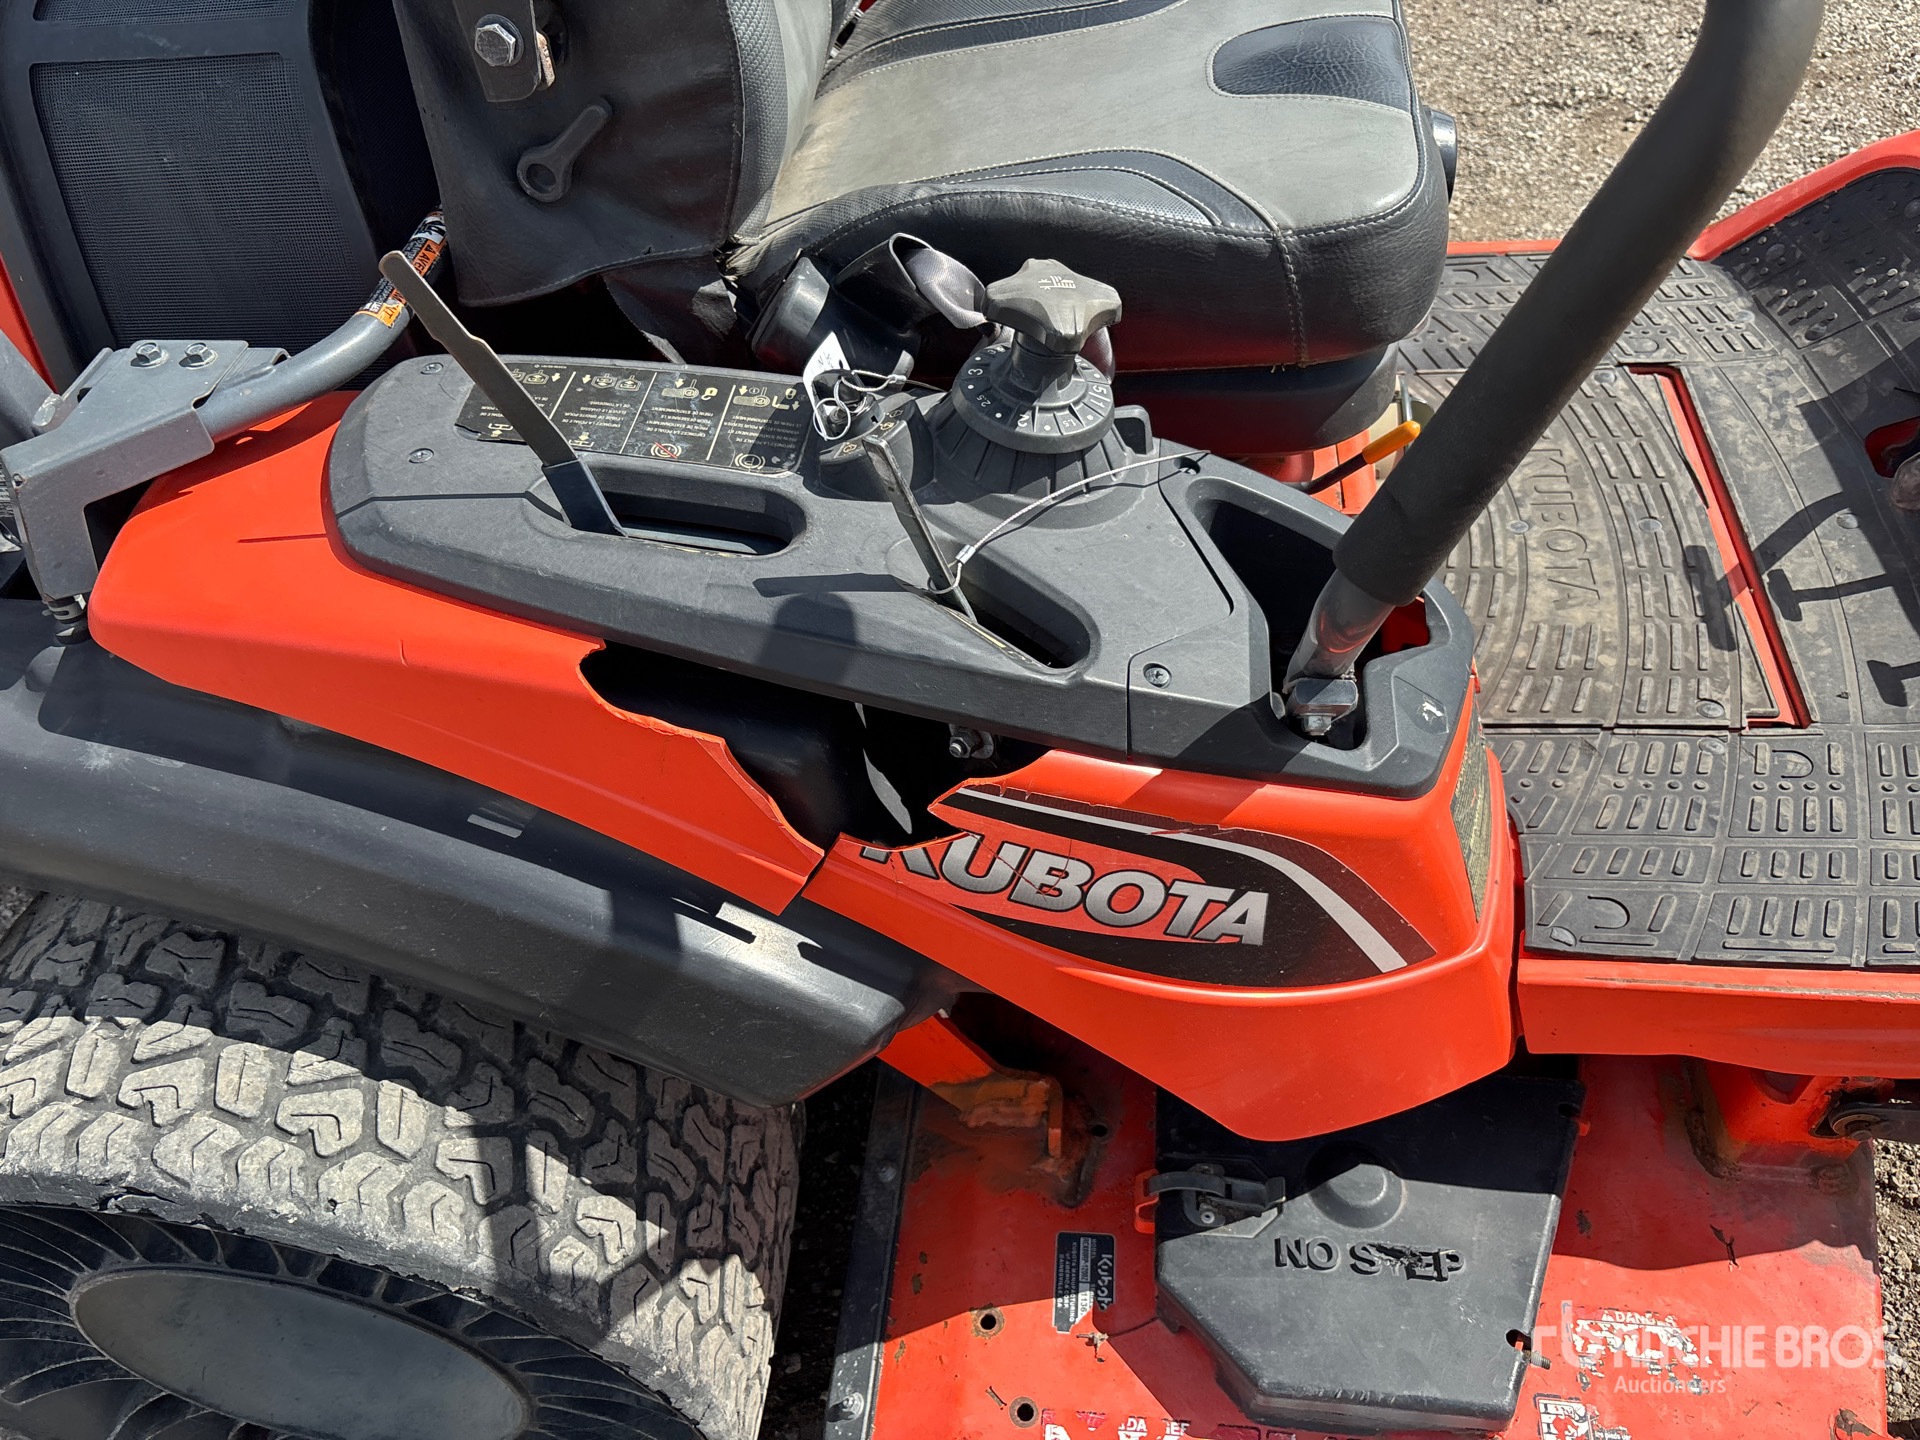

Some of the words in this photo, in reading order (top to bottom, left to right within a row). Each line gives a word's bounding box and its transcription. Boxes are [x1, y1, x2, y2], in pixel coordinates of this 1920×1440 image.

[967, 368, 984, 376] 3
[976, 394, 992, 408] 2.5
[1017, 413, 1030, 428] 2
[1062, 418, 1077, 428] 1.5
[1527, 449, 1600, 610] KUBOTA
[1274, 1236, 1340, 1276] NO
[1068, 1267, 1076, 1322] MANUFACTURING
[1056, 1297, 1063, 1308] GA
